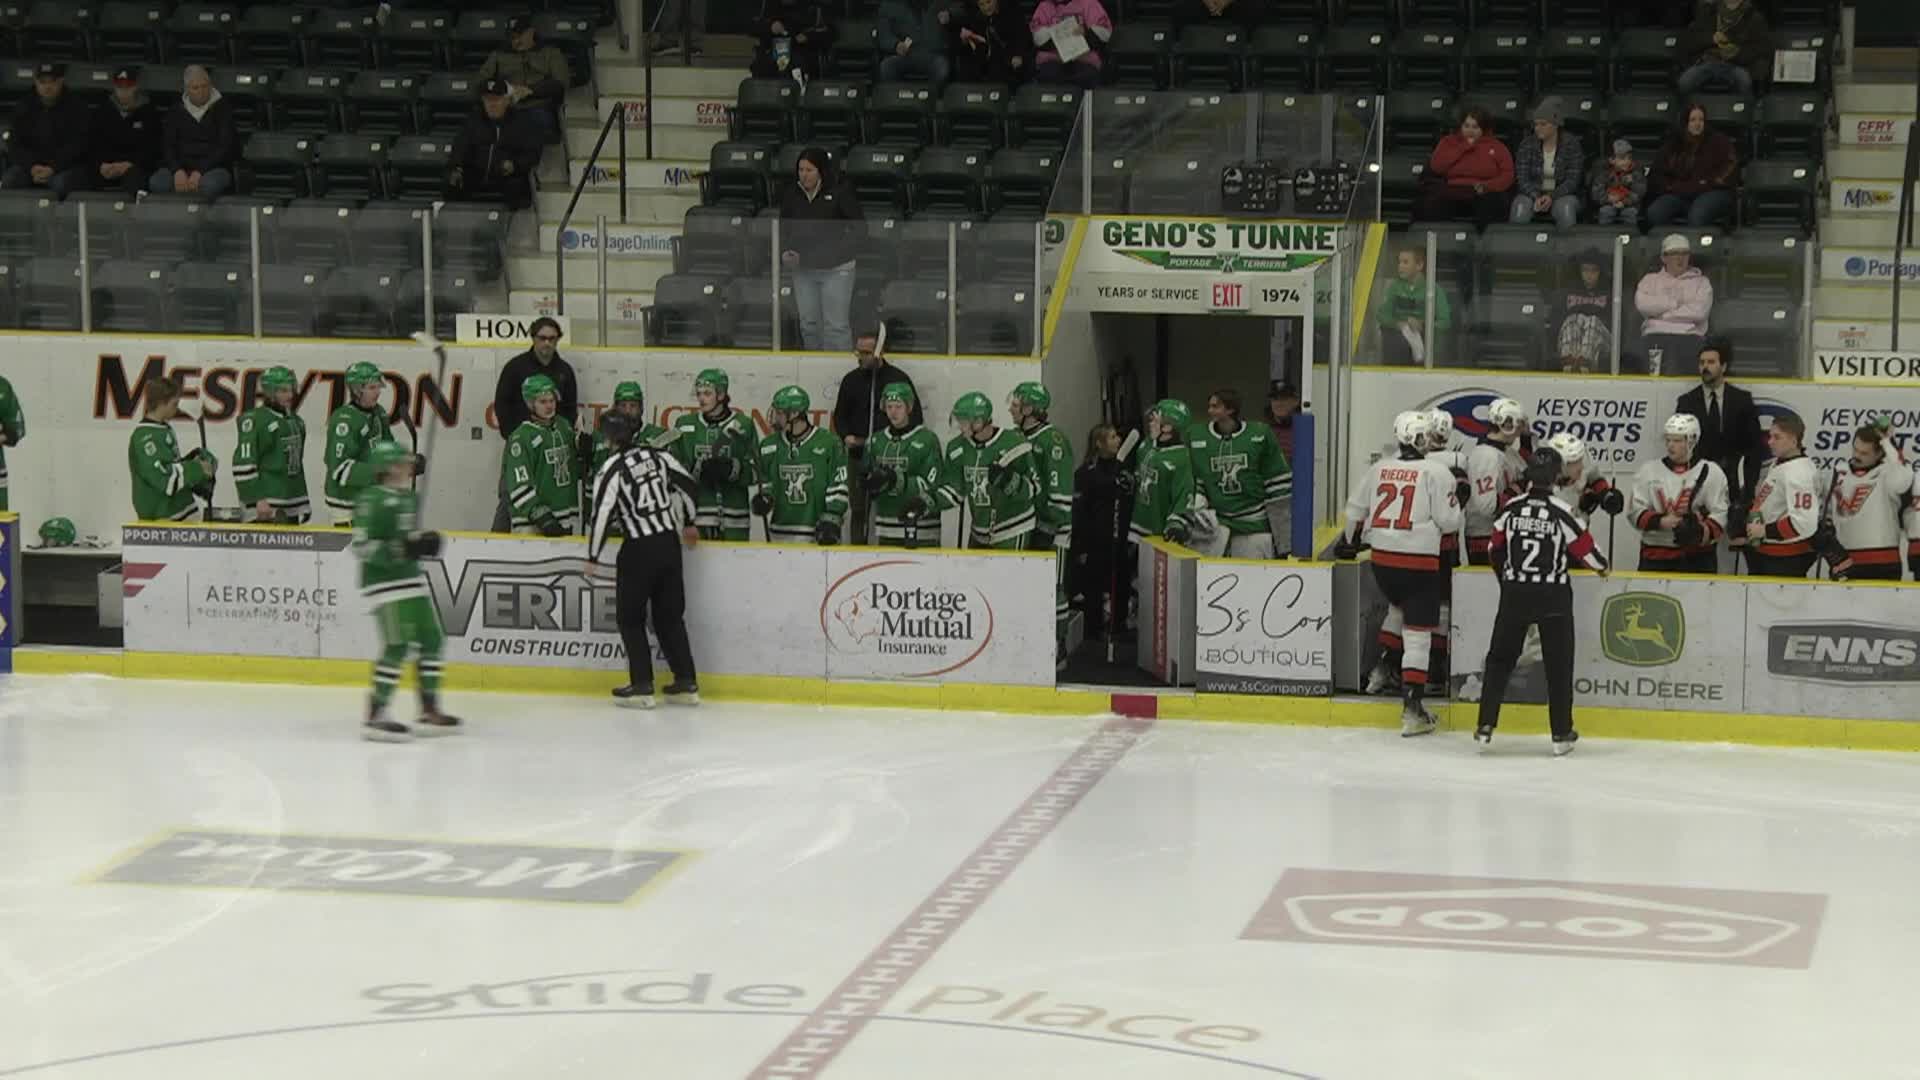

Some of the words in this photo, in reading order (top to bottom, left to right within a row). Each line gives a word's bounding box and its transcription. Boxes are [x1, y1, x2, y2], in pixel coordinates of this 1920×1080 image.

[623, 103, 647, 114] FRY
[696, 103, 730, 114] CFRY
[1857, 120, 1895, 131] CFRY
[581, 232, 672, 251] PotageOnline
[1103, 221, 1216, 248] GENO'S
[1170, 258, 1211, 268] PORTAGE
[1243, 259, 1288, 269] TERRIERS
[1098, 286, 1134, 298] YEARS
[1151, 287, 1200, 300] SERVICE
[1262, 288, 1300, 303] 1974
[1213, 284, 1242, 307] EXIT
[475, 319, 533, 338] HOM
[1819, 354, 1920, 378] VISITOR
[1537, 398, 1648, 418] KEYSTONE
[1531, 420, 1642, 443] SPORTS
[240, 443, 251, 459] 11
[514, 465, 529, 482] 13
[637, 477, 671, 511] 40
[1476, 475, 1495, 496] 12
[1370, 483, 1417, 530] 21
[1793, 492, 1812, 510] 18
[1512, 516, 1555, 534] FRIESEN
[124, 529, 167, 541] PPORT
[210, 532, 247, 544] PILOT
[251, 533, 314, 546] TRAINING
[1521, 537, 1540, 573] 2
[206, 585, 337, 606] AEROSPACE
[422, 559, 618, 637] VERTE
[871, 582, 967, 619] Portage
[283, 609, 301, 622] 50
[880, 610, 974, 640] Mutual
[470, 637, 626, 659] CONSTRUCTION
[878, 638, 947, 656] Insurance
[1783, 634, 1918, 667] ENNS
[1206, 648, 1327, 668] BOUTIQUE
[1206, 679, 1328, 696] www.3sCompany.ca
[1574, 677, 1630, 697] OHN
[1636, 676, 1724, 700] DEERE
[361, 968, 807, 1014] Stride
[905, 984, 1263, 1051] Place
